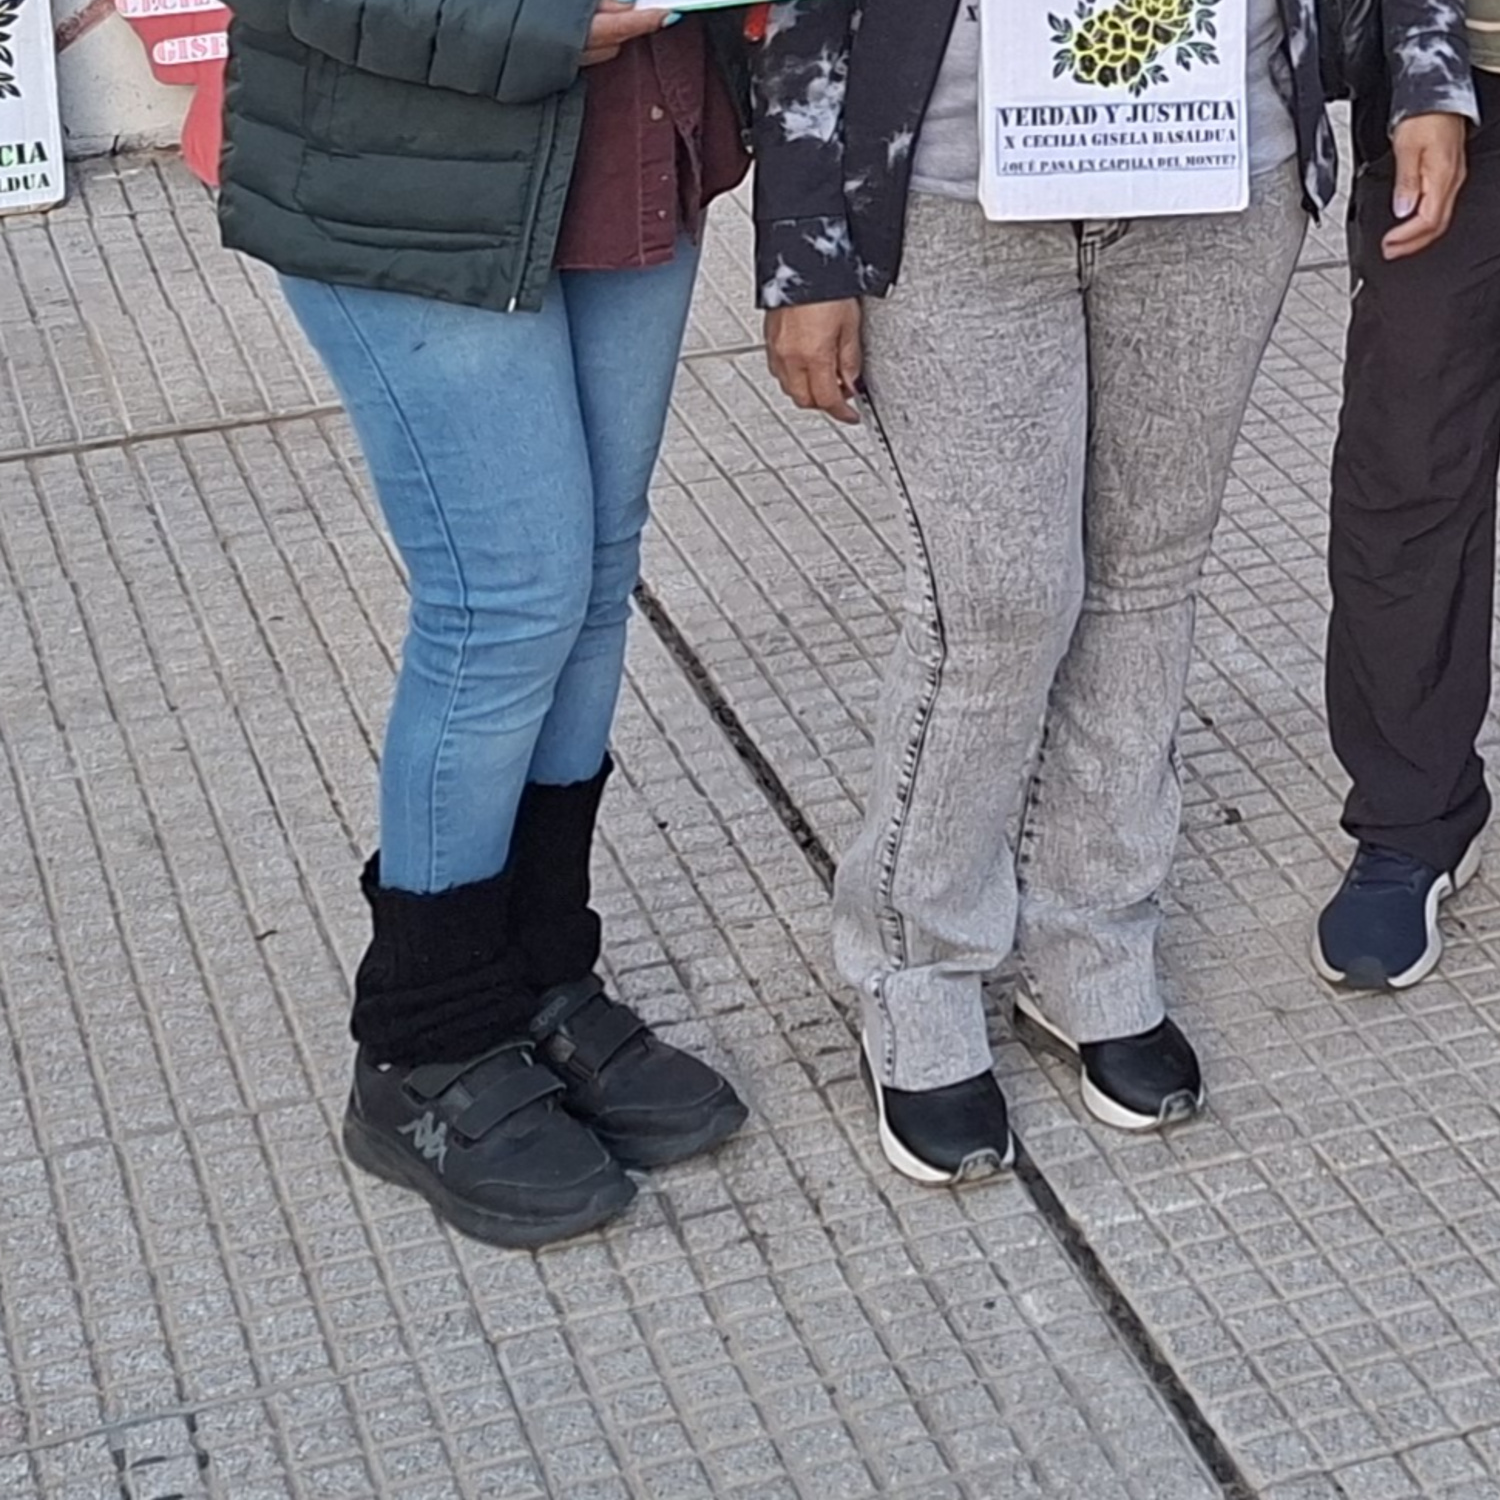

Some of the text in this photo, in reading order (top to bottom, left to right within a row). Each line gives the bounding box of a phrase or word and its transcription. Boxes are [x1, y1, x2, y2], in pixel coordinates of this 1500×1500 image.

[999, 100, 1236, 127] VERDAD Y JUSTICIA
[1004, 129, 1236, 149] X CECILIA GISELA BASALDUA
[1002, 154, 1236, 173] ¿QUÉ PASA EN CAPILLA DEL MONTE?
